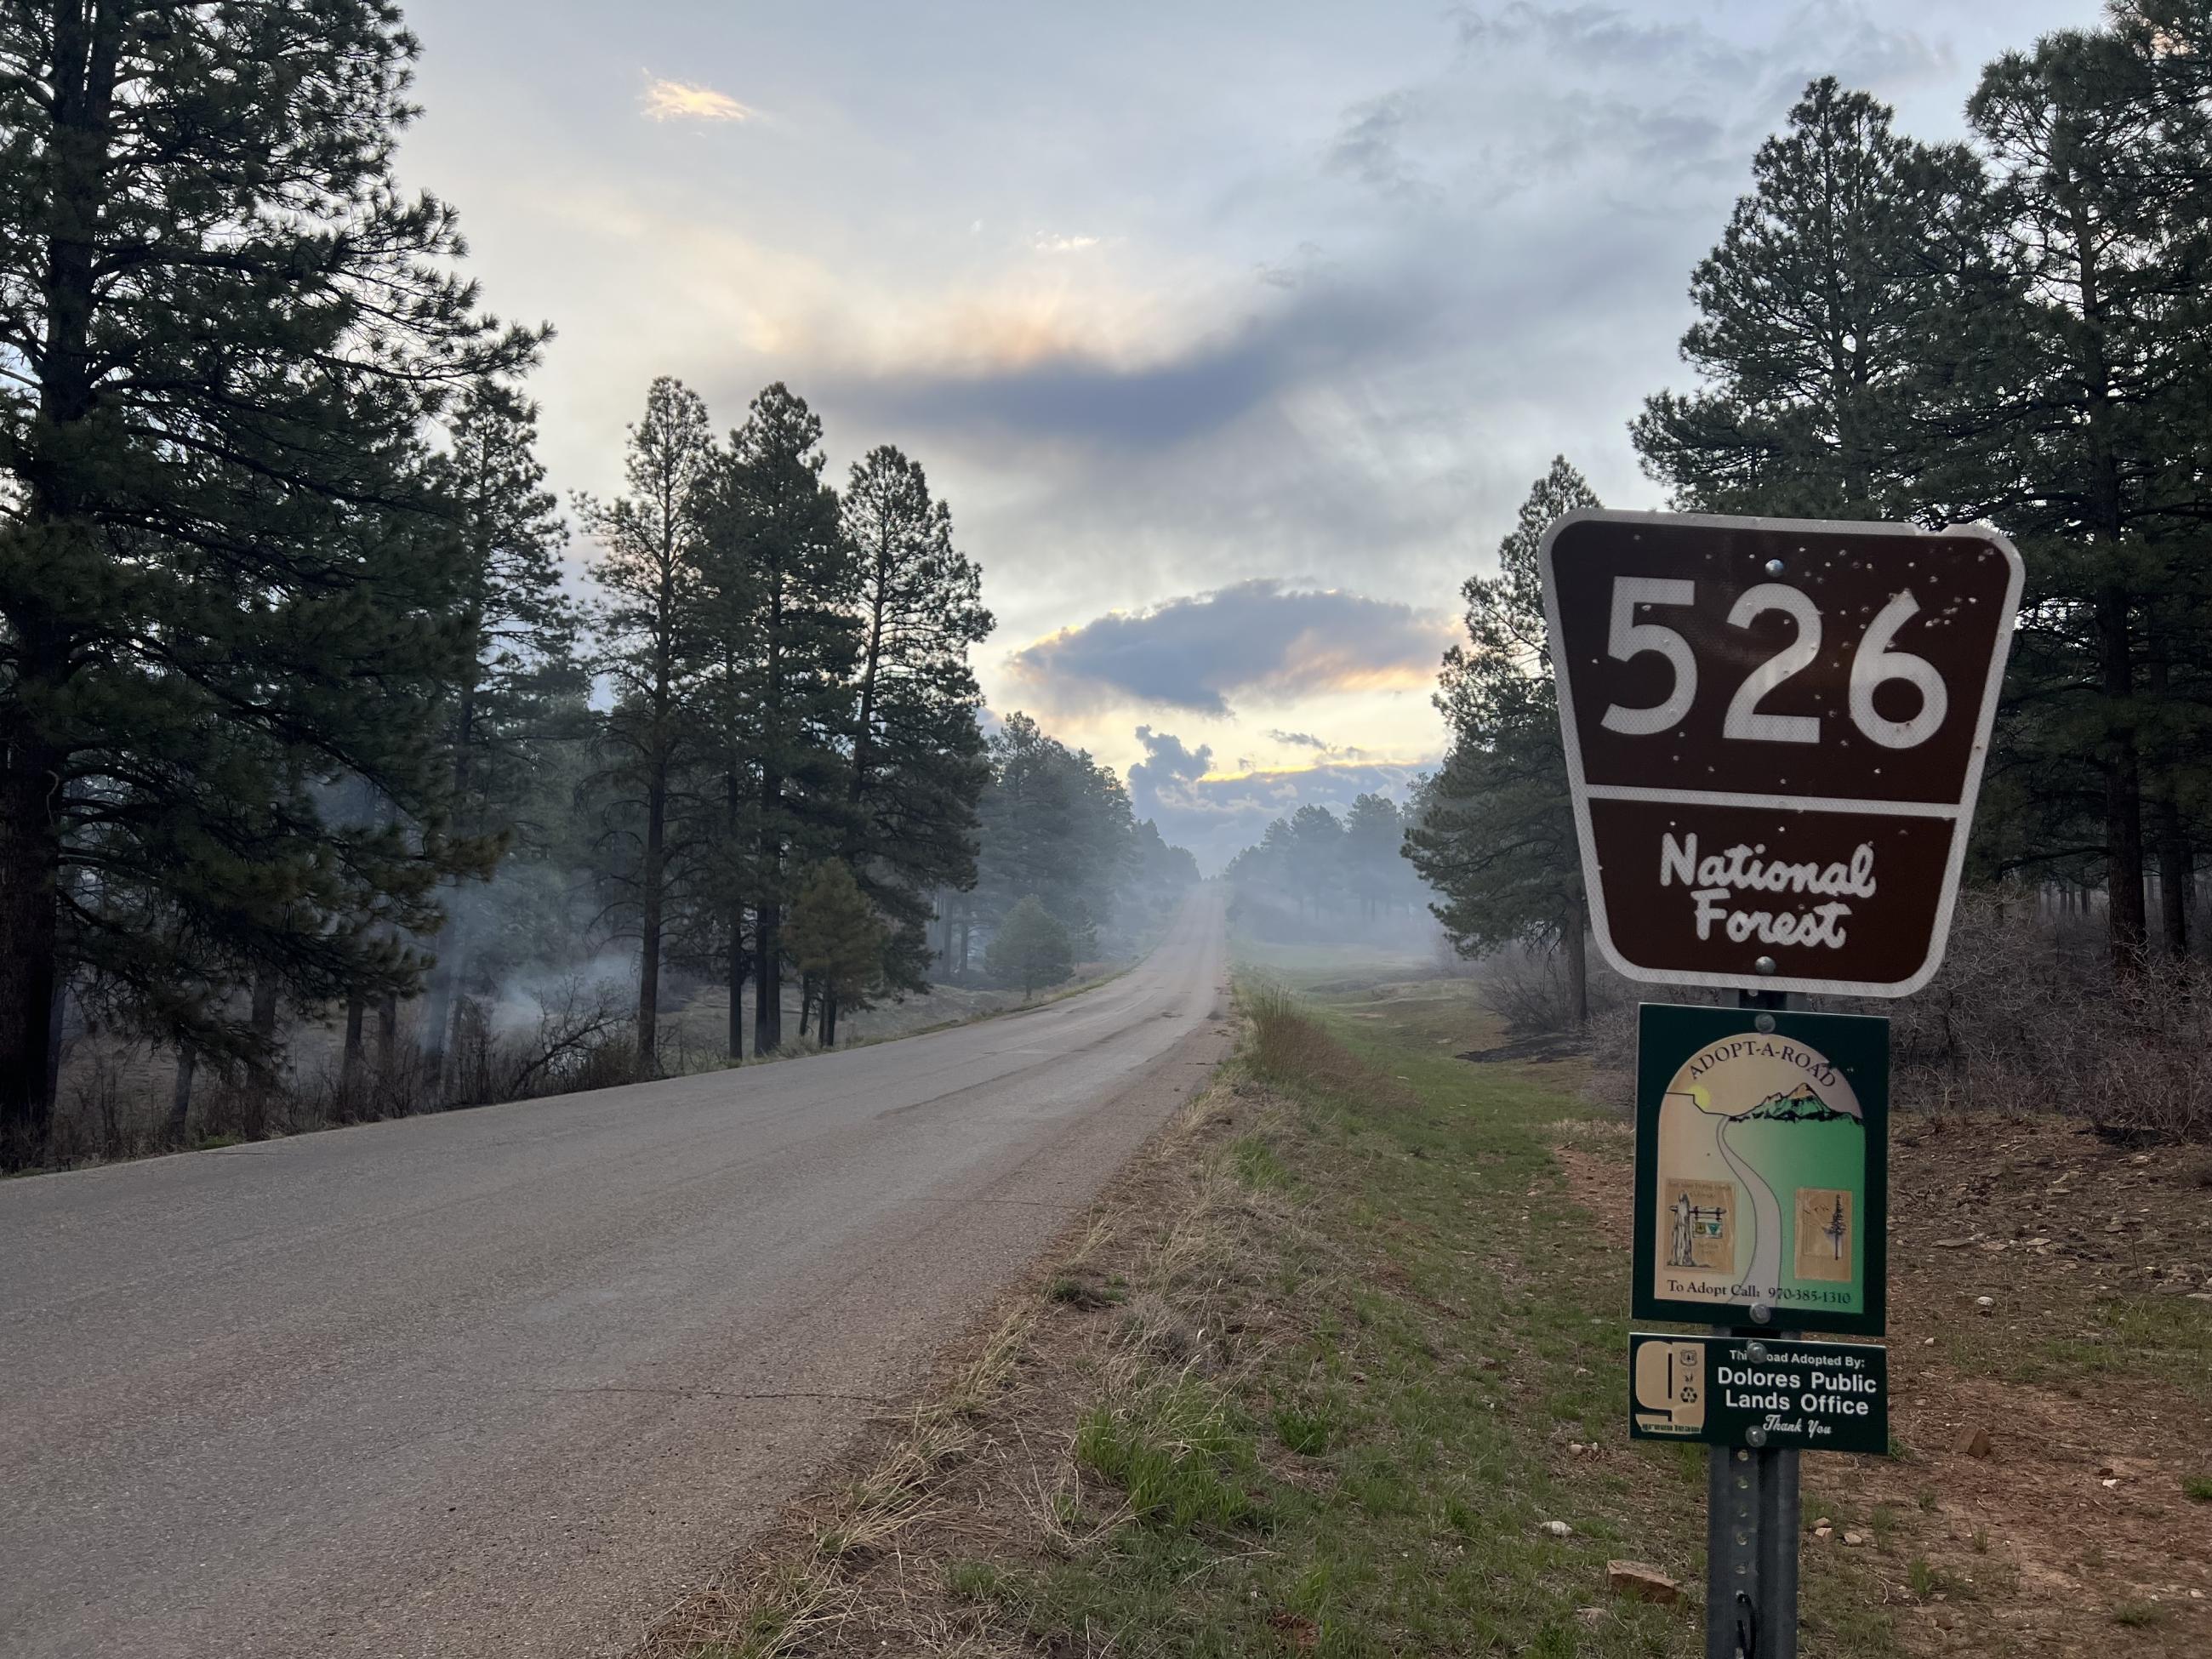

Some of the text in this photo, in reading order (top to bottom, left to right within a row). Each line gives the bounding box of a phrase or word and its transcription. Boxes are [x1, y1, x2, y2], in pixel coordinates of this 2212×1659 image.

[1599, 575, 1948, 750] 526
[1661, 832, 1877, 898] National
[1690, 889, 1851, 949] Forest
[1689, 1040, 1836, 1087] ADOPT-A-ROAD
[1667, 1280, 1851, 1304] To Adopt Call: 970-385-1310
[1729, 1349, 1748, 1360] Thi
[1764, 1352, 1788, 1363] oad
[1791, 1354, 1841, 1367] Adopted
[1718, 1367, 1877, 1393] Dolores Public
[1725, 1389, 1869, 1415] Lands Office
[1763, 1414, 1832, 1439] Thank You
